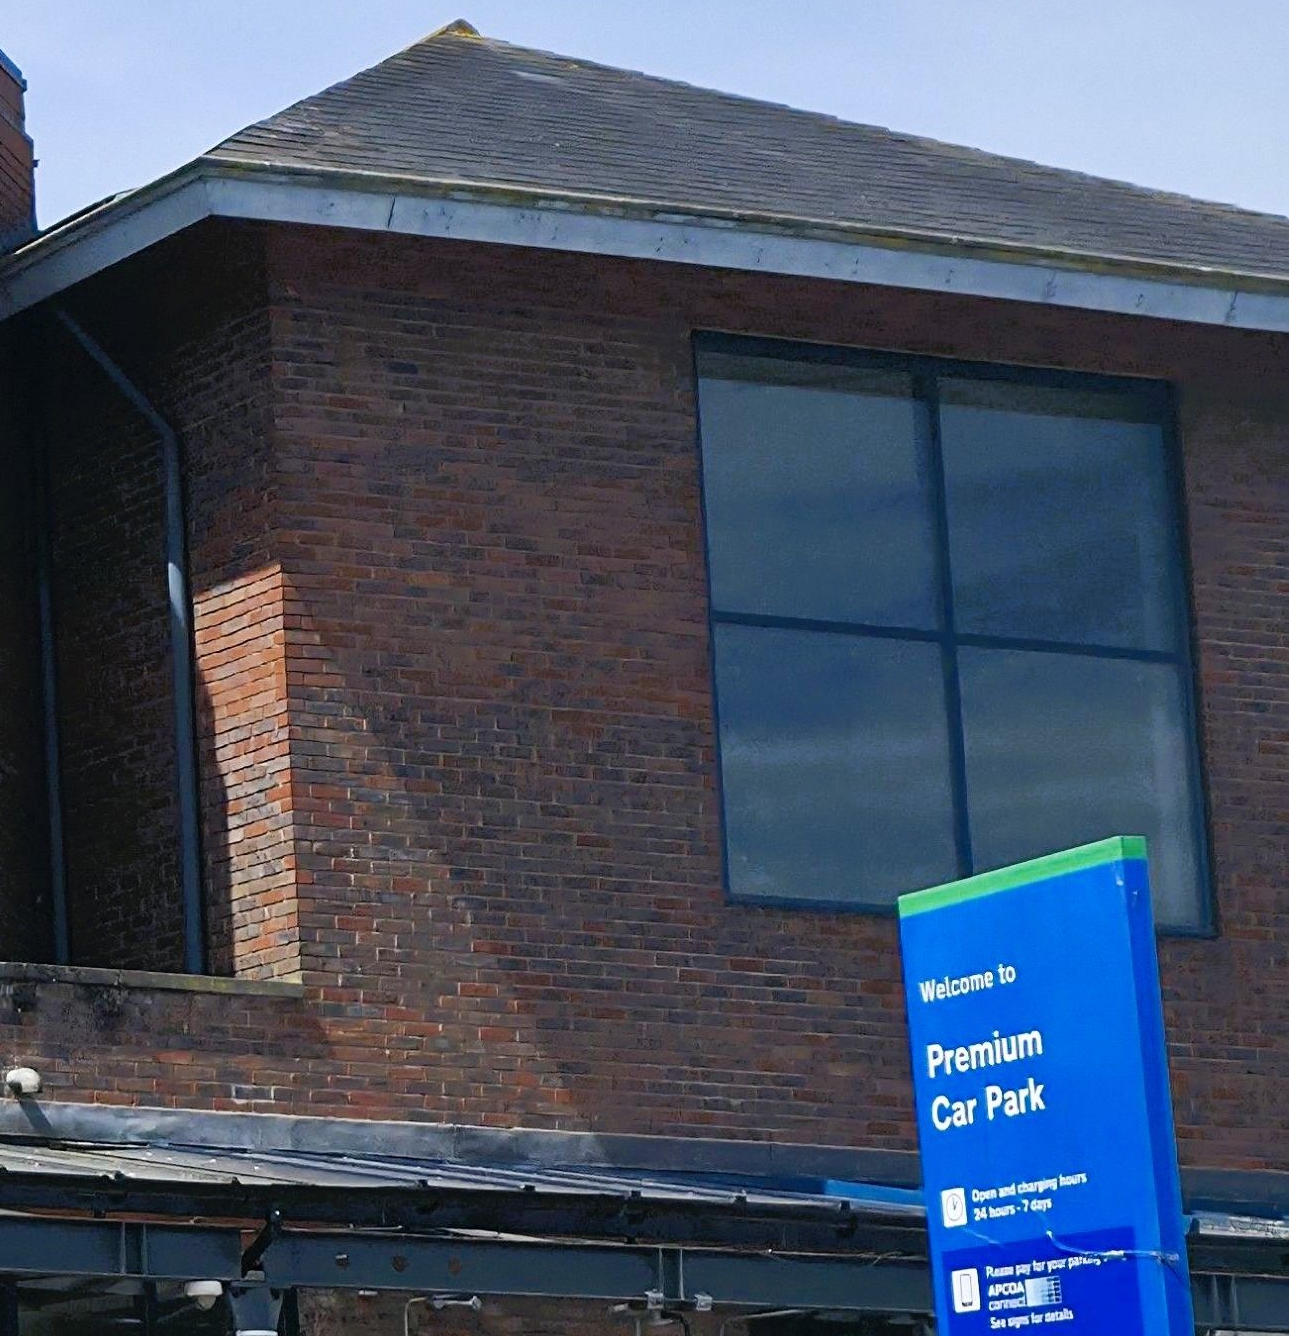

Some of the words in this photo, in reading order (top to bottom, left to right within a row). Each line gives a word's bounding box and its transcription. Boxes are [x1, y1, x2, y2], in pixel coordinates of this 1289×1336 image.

[918, 970, 994, 1003] Welcome
[997, 963, 1017, 984] to
[926, 1029, 1043, 1079] Premium
[931, 1095, 978, 1131] Car
[985, 1077, 1045, 1121] Park
[972, 1188, 998, 1204] Open
[998, 1183, 1016, 1198] and
[1018, 1175, 1058, 1195] charging
[1059, 1172, 1088, 1188] hours
[973, 1209, 988, 1222] 24
[989, 1204, 1016, 1219] hours
[1022, 1199, 1029, 1212] 7
[1030, 1197, 1053, 1213] days
[988, 1281, 1025, 1297] APCOA
[990, 1316, 1007, 1330] See
[1031, 1311, 1044, 1325] for
[1044, 1308, 1074, 1323] details
